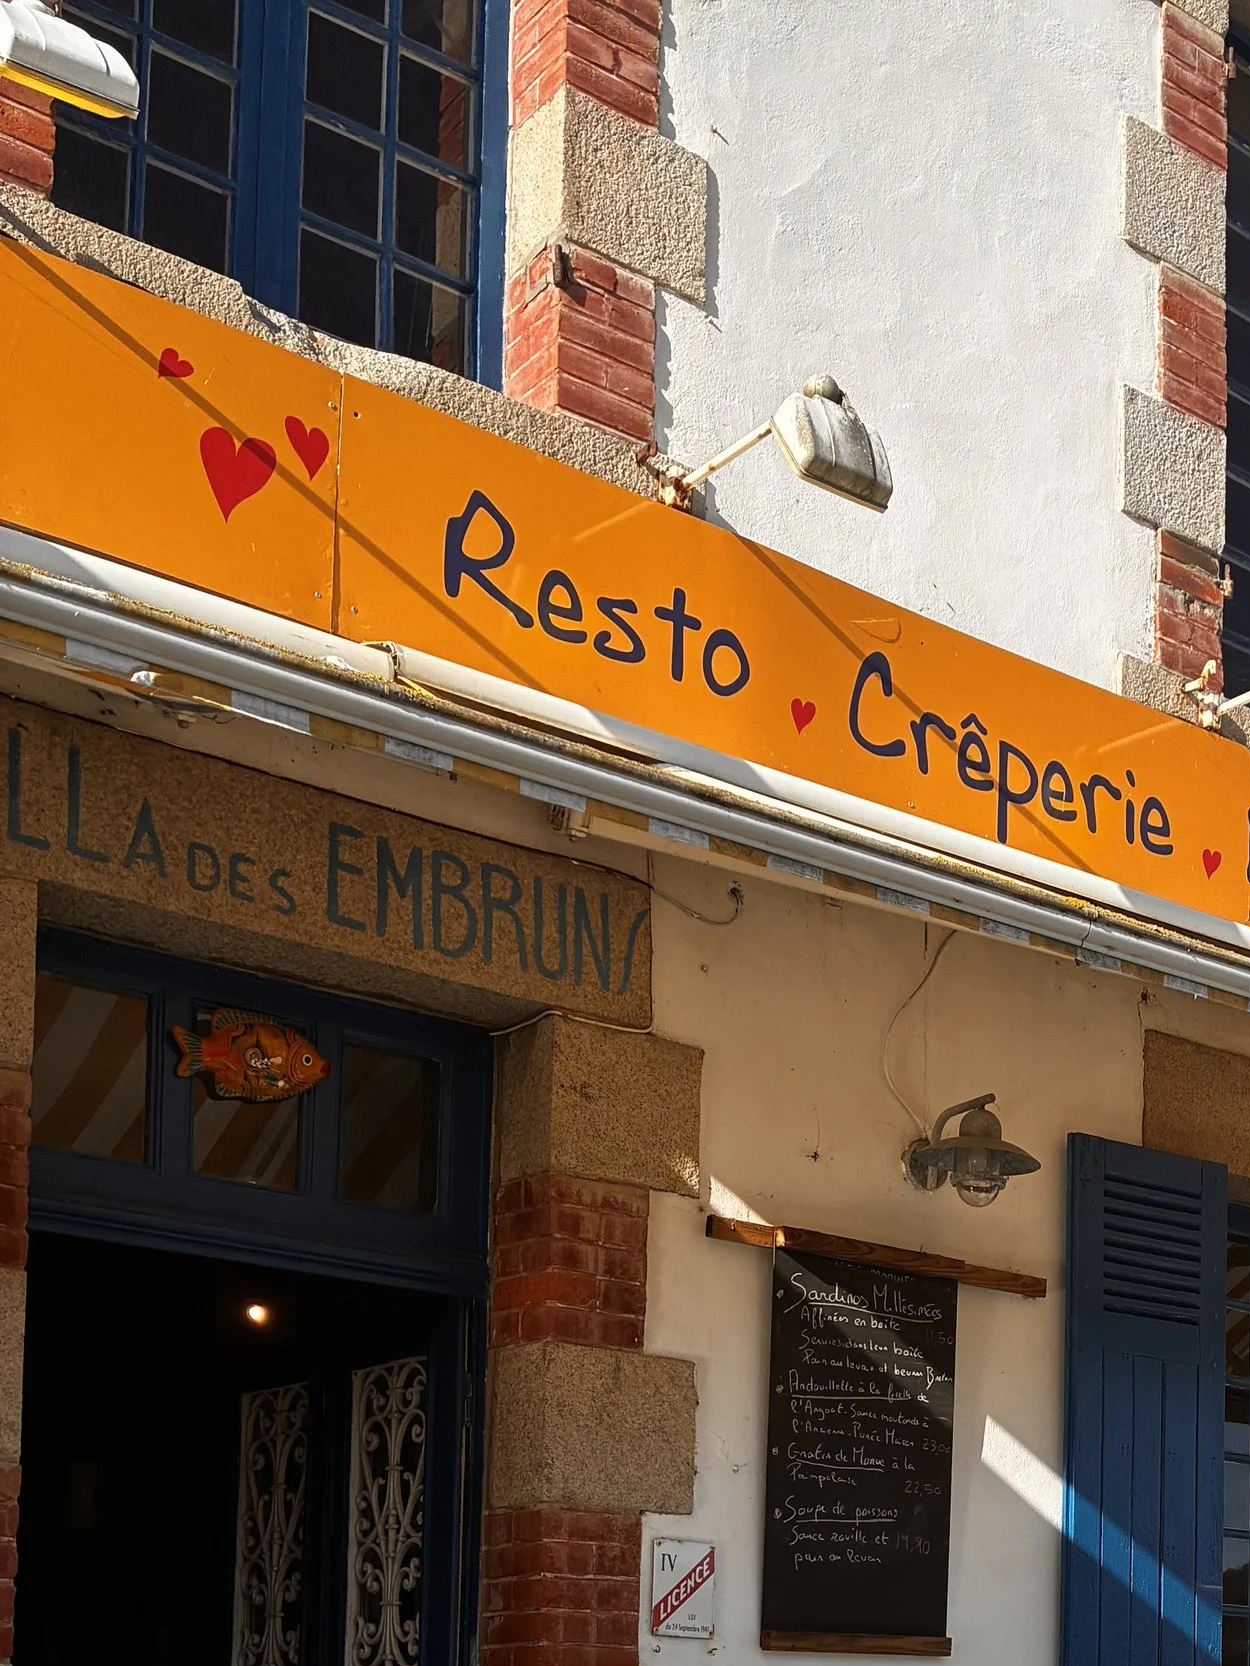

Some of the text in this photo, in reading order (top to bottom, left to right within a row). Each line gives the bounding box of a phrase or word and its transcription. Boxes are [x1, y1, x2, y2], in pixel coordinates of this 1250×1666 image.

[442, 488, 752, 697] Resto
[848, 650, 1174, 856] Crêperie
[187, 841, 297, 916] DES
[904, 1458, 915, 1471] la
[660, 1557, 710, 1620] LICENCE
[661, 1553, 677, 1572] IV
